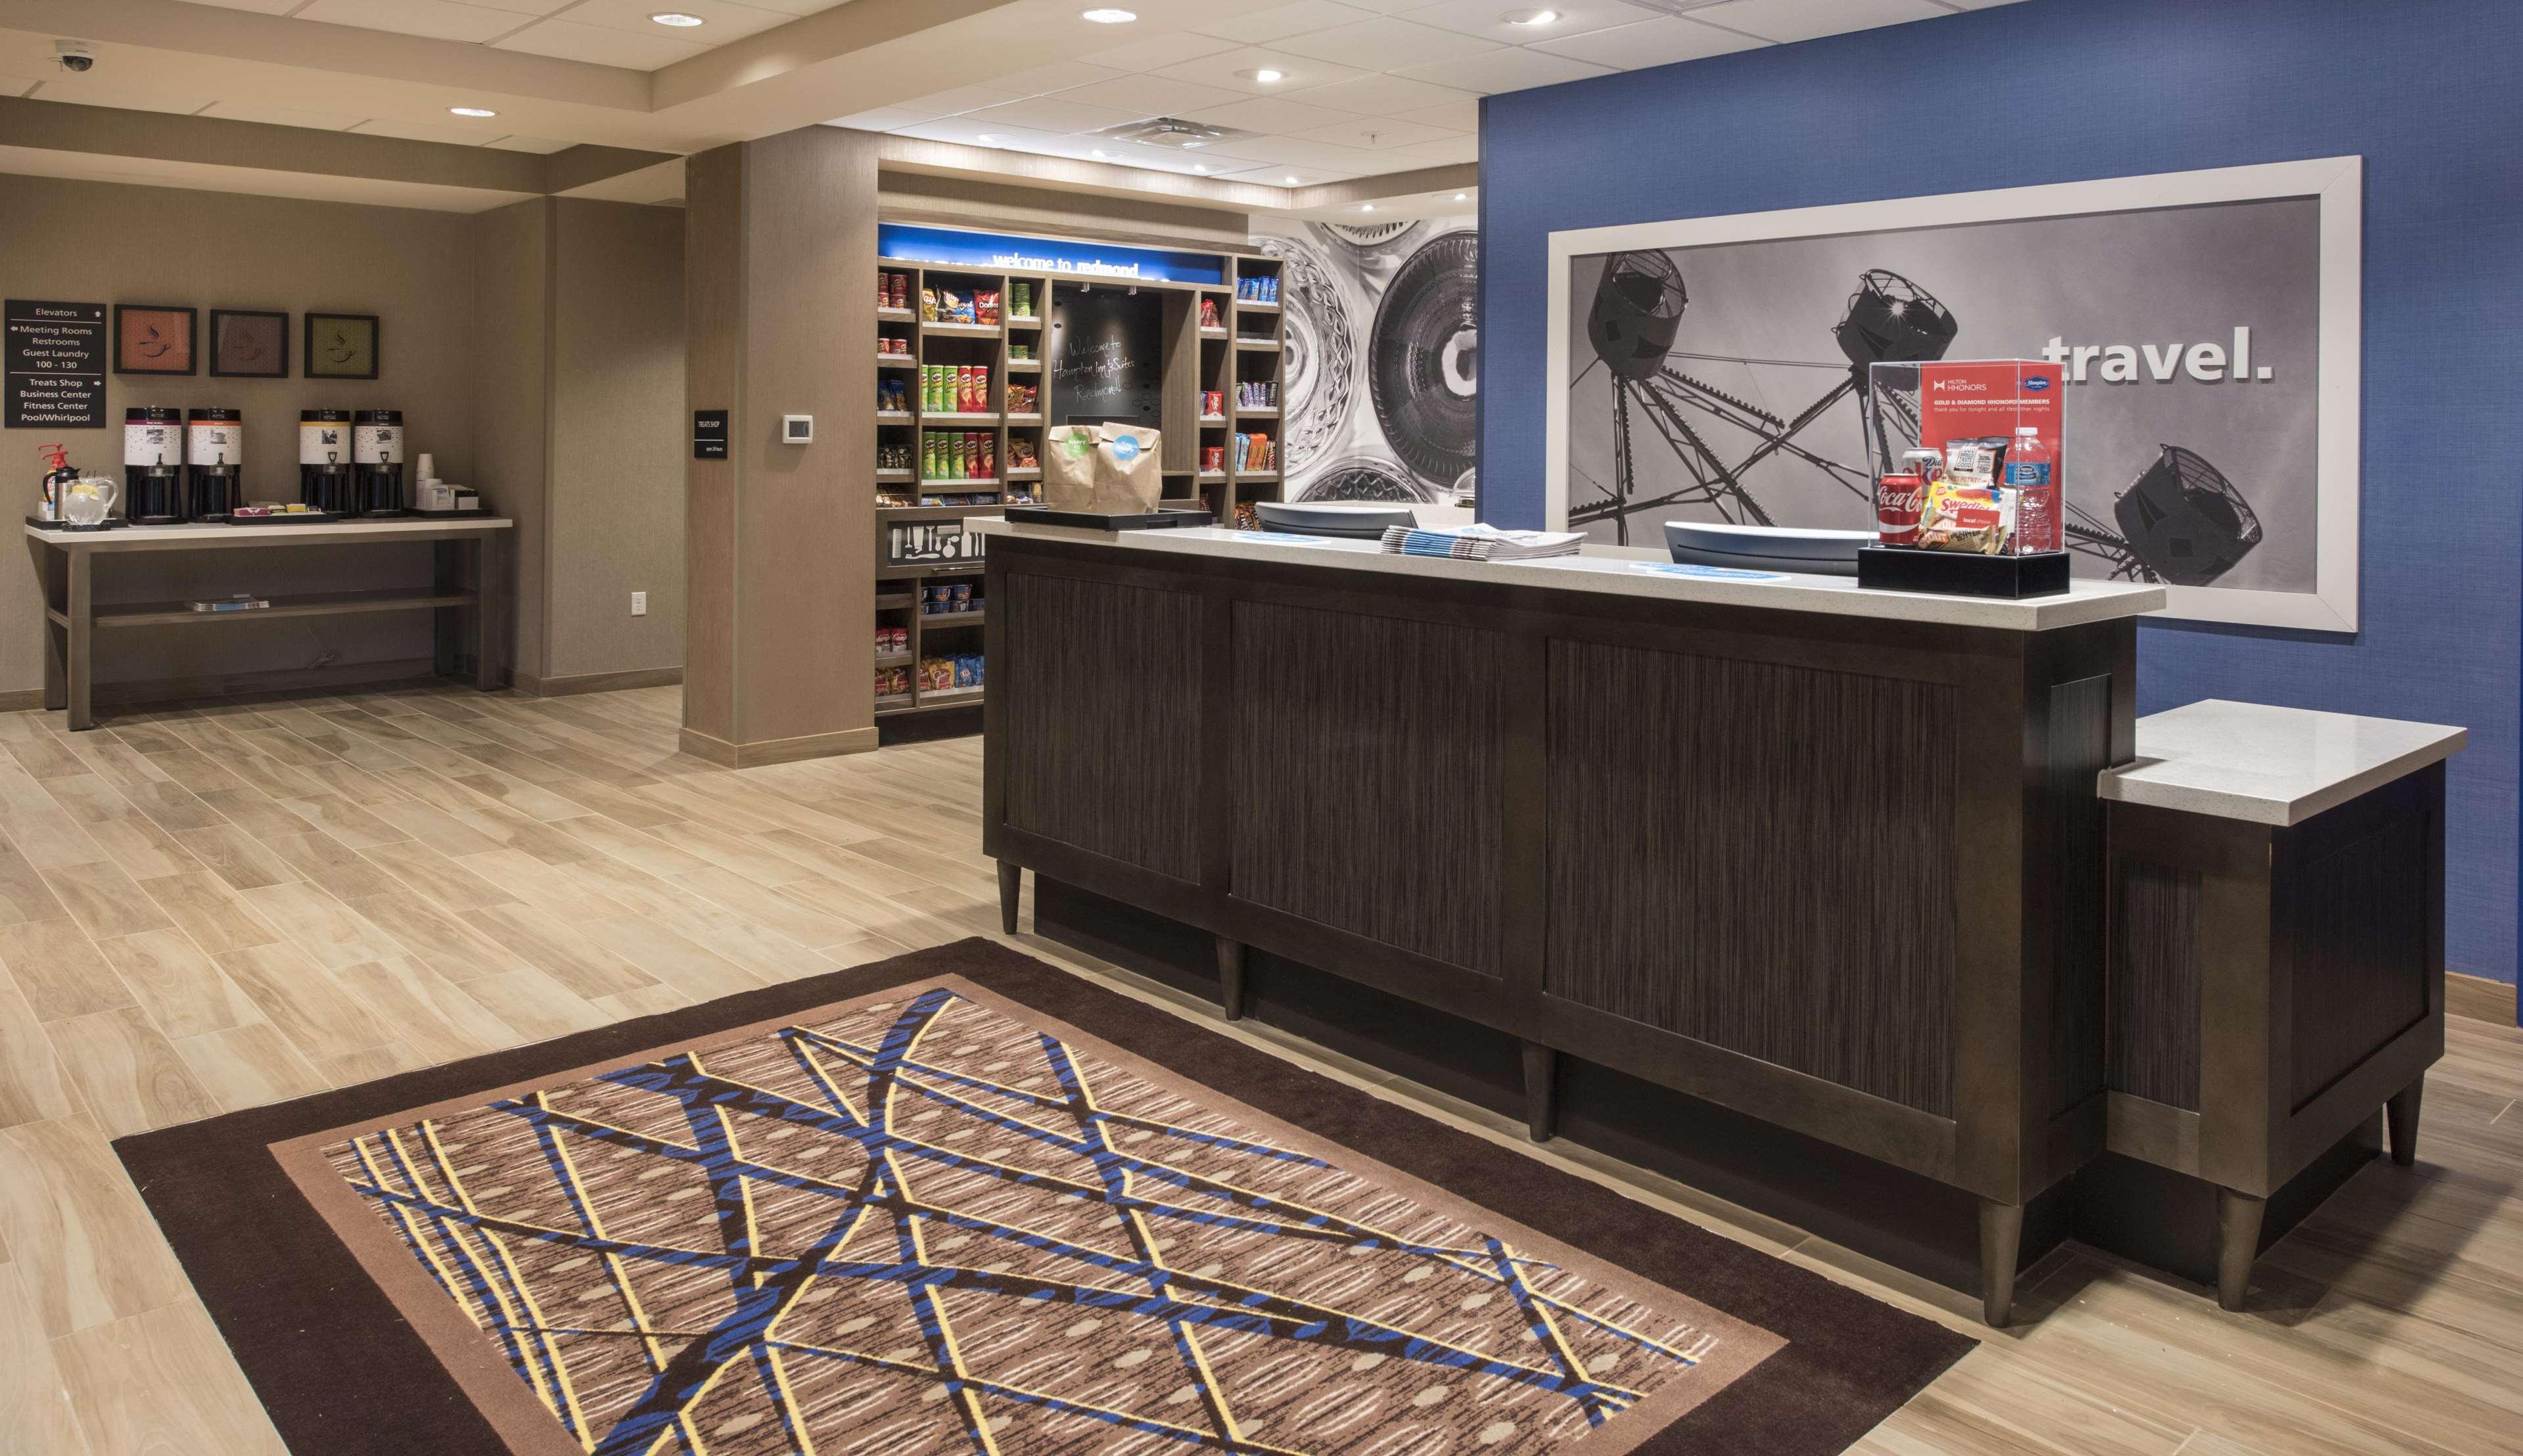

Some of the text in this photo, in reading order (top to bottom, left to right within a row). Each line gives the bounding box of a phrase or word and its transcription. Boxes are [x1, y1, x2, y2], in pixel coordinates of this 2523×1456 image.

[993, 252, 1138, 276] welcome to redmond
[35, 308, 78, 317] Elevators
[20, 326, 59, 335] Meeting
[1070, 335, 1110, 357] Welcome
[2042, 326, 2273, 381] travel.
[53, 350, 89, 359] Laundry
[1052, 359, 1094, 382] Hampton
[1096, 361, 1109, 378] Inn
[1113, 357, 1135, 371] Suites
[60, 379, 83, 388] Shop
[22, 414, 90, 422] Pool/Whirlpool
[1877, 486, 1922, 512] Coca-Co
